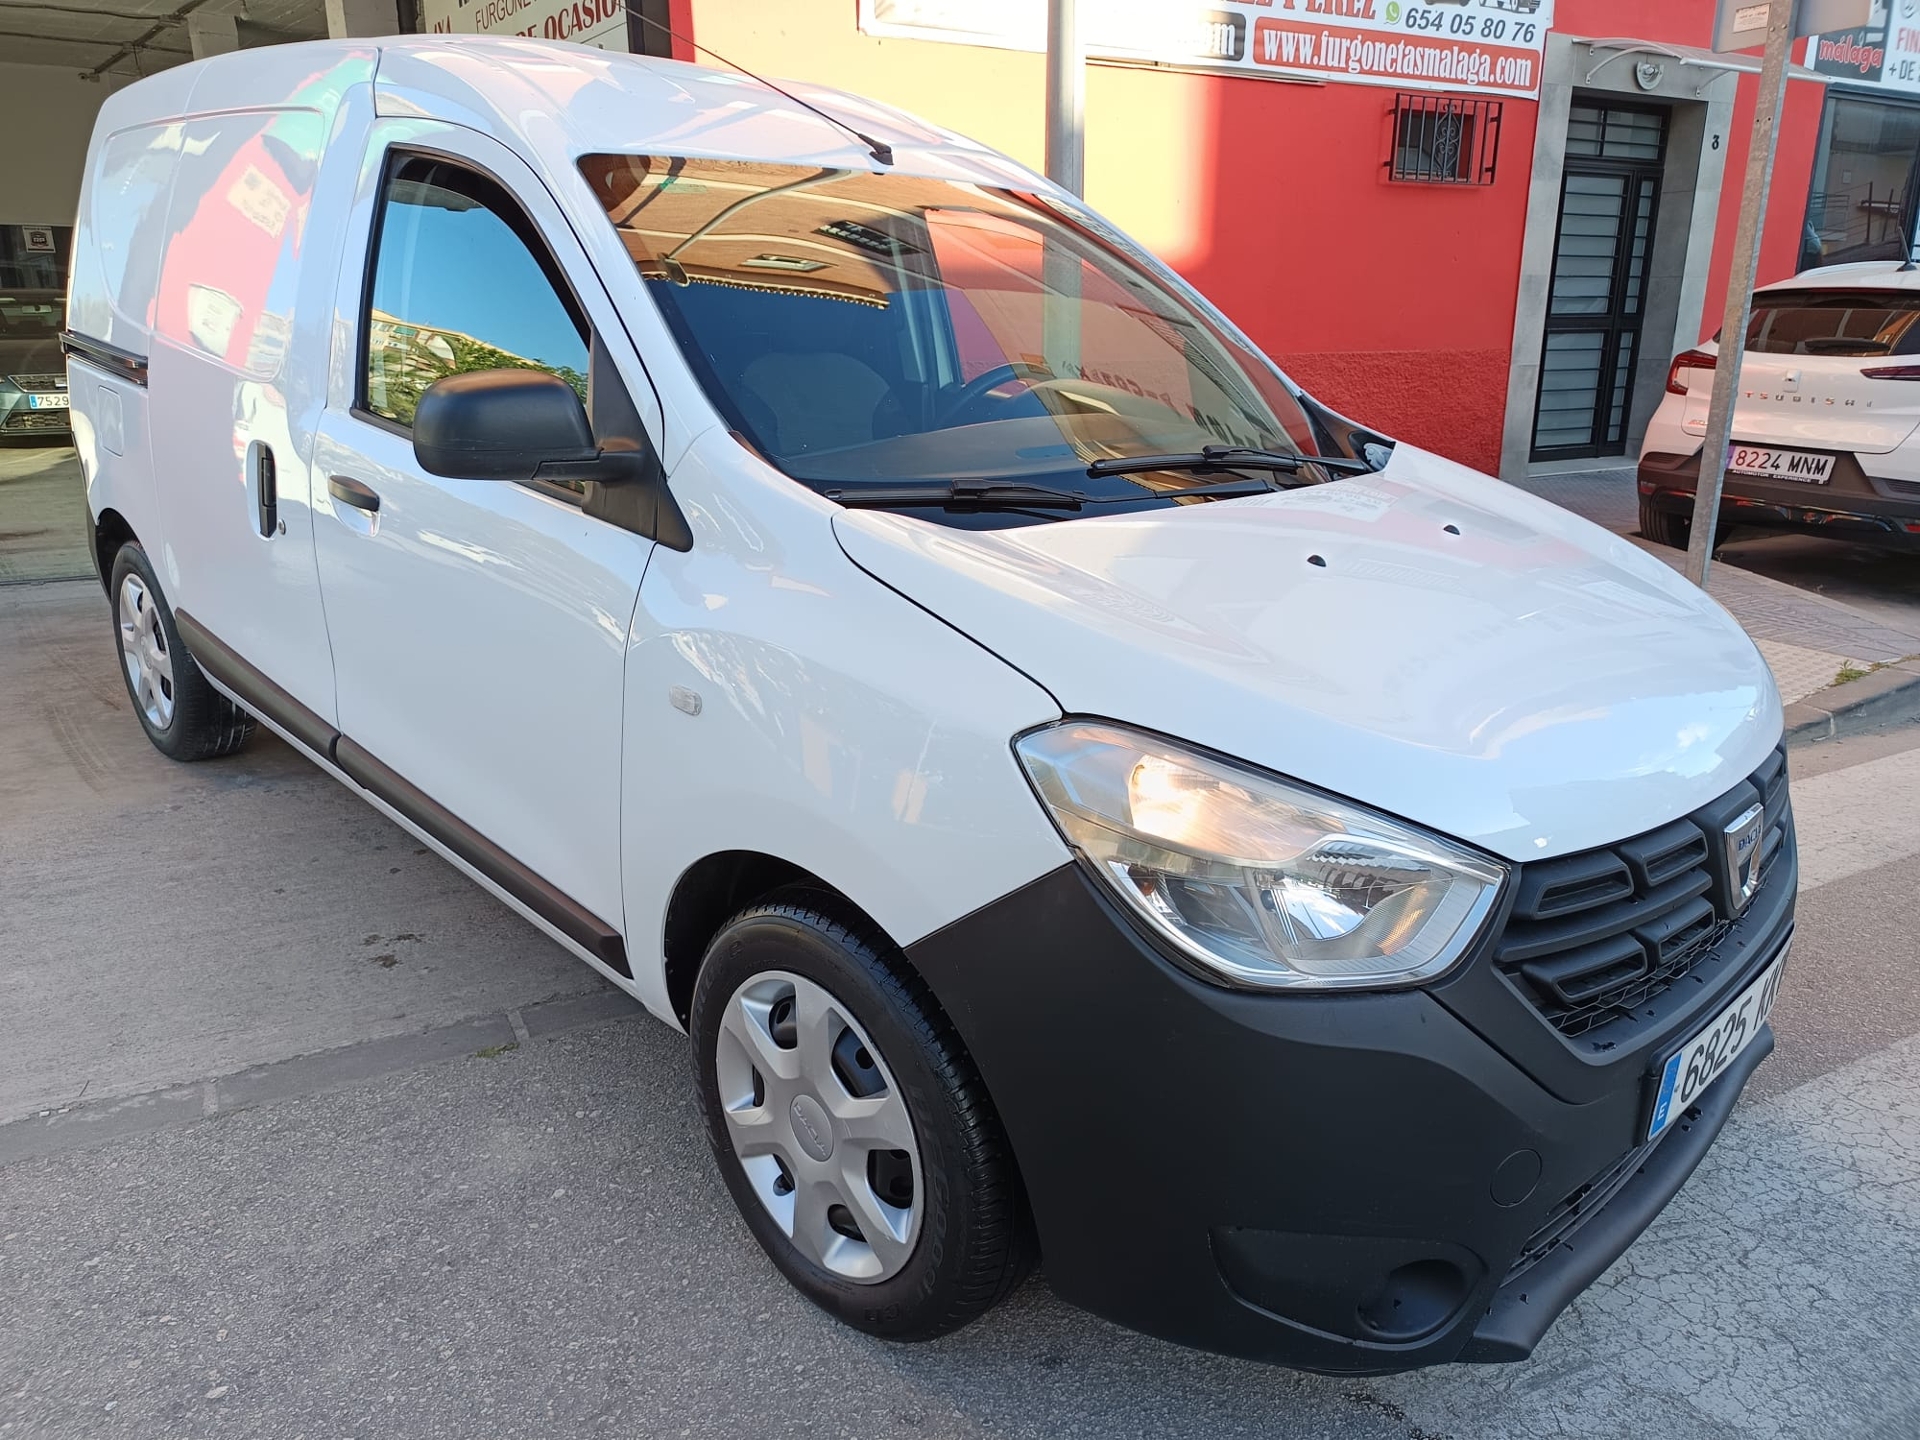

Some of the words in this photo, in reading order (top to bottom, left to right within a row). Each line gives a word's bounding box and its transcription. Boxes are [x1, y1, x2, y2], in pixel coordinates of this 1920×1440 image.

[1405, 7, 1444, 32] 654
[1450, 13, 1476, 36] 05
[1480, 17, 1506, 40] 80
[1511, 21, 1537, 43] 76
[1818, 34, 1884, 74] málaga
[1896, 27, 1920, 54] FIN
[1262, 29, 1532, 87] www.furgonetasmalaga.com
[1711, 134, 1720, 150] 3
[37, 396, 69, 406] 7529
[1743, 391, 1874, 408] TSUBISHI
[1735, 449, 1783, 471] 8224
[1787, 455, 1829, 476] MNM
[1680, 994, 1753, 1103] 6825
